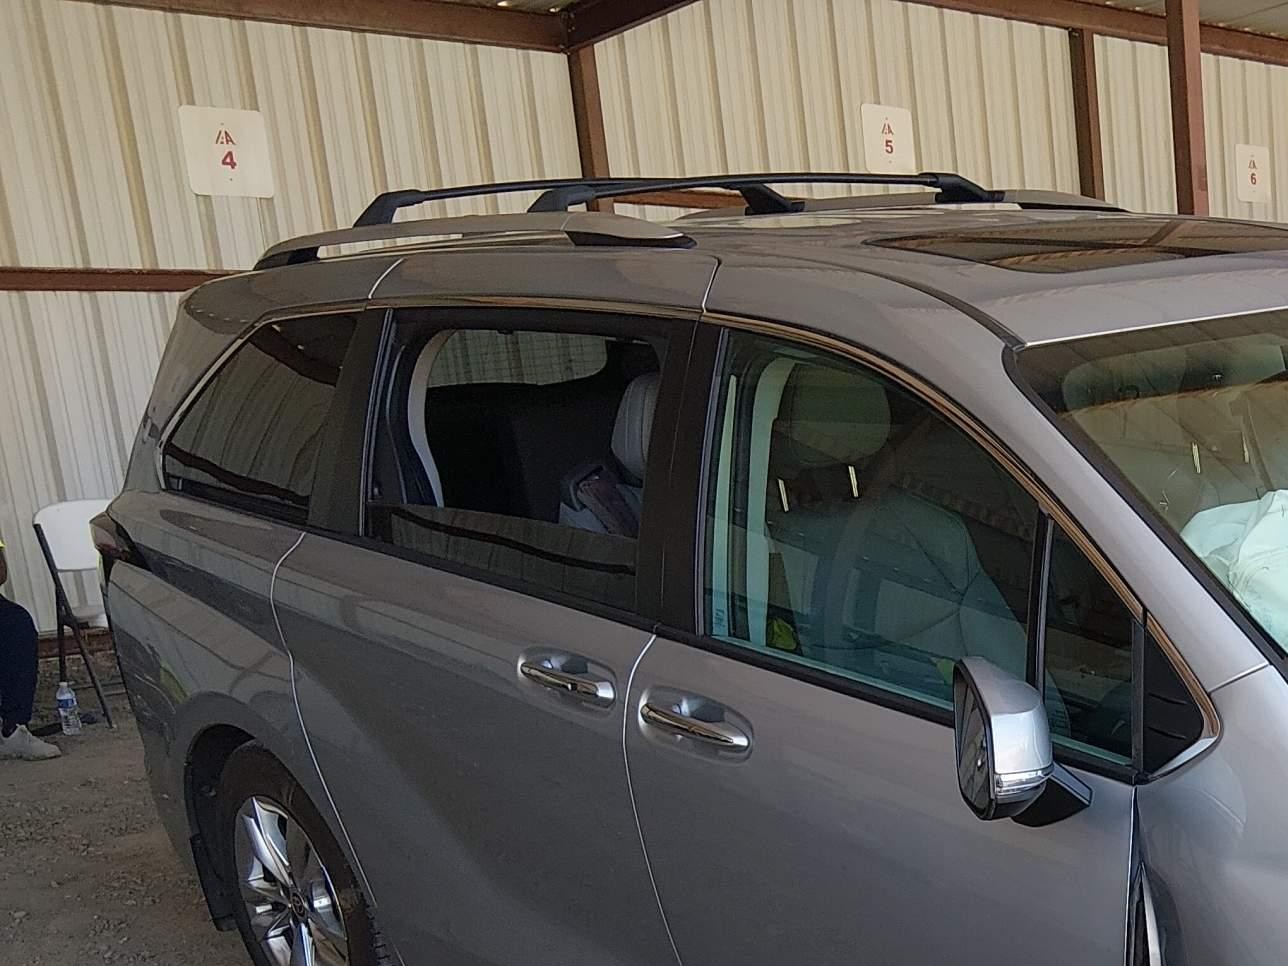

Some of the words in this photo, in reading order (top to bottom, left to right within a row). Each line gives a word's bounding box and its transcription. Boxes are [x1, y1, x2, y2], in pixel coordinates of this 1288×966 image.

[885, 139, 893, 154] 5
[221, 150, 238, 170] 4
[1250, 172, 1257, 185] 6
